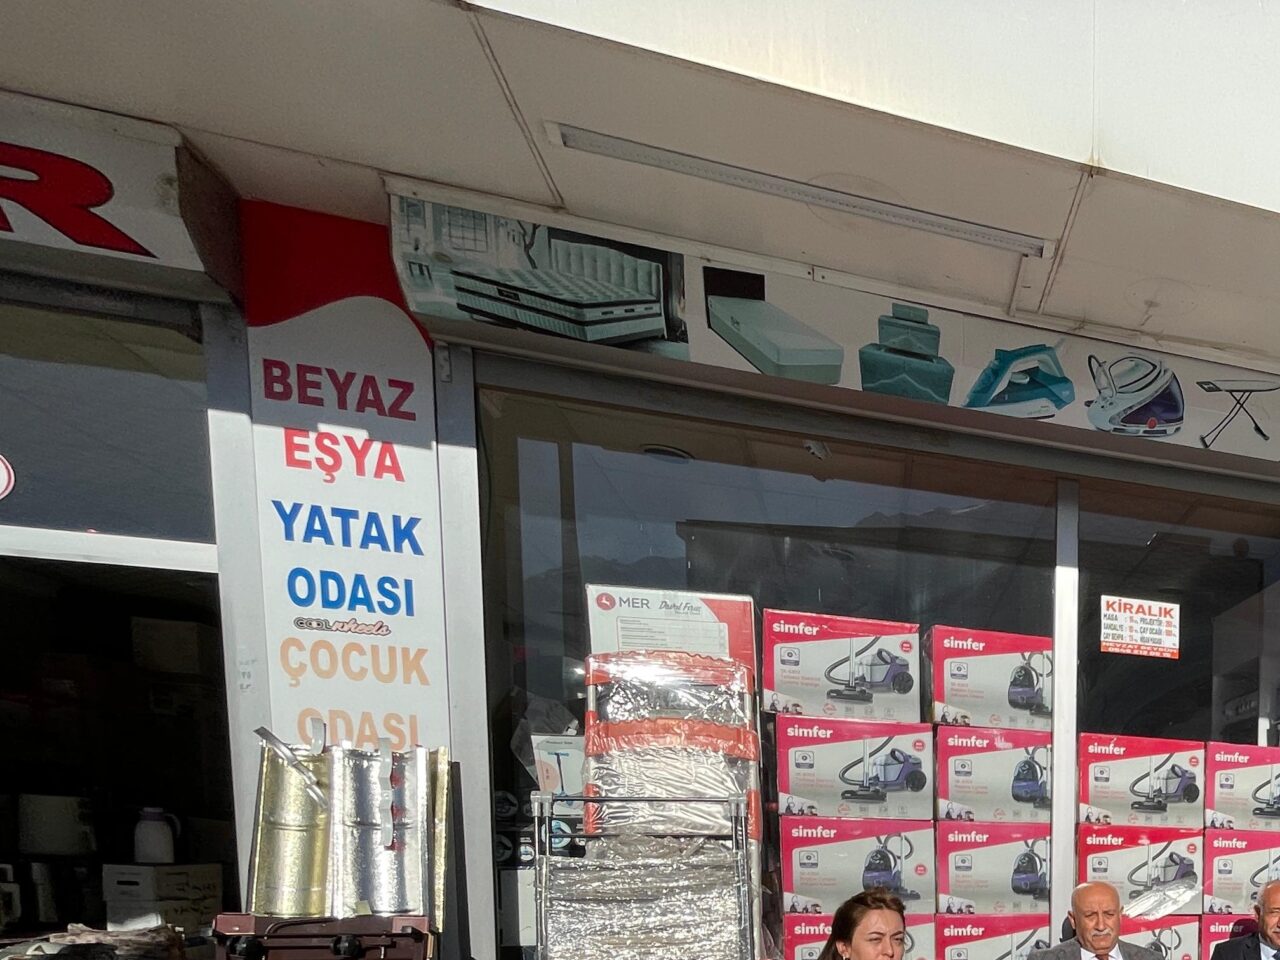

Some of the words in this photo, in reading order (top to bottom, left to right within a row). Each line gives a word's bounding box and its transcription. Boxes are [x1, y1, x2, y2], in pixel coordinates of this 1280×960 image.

[262, 358, 416, 421] BEYAZ
[284, 428, 405, 483] EŞYA
[271, 499, 424, 556] YATAK
[287, 567, 414, 617] ODASI
[619, 597, 650, 609] MER
[1106, 599, 1174, 619] KİRALIK
[773, 621, 819, 636] simfer
[944, 637, 985, 651] simfer
[280, 636, 430, 687] ÇOCUK
[297, 708, 418, 752] ODASI
[787, 725, 833, 739] simfer
[948, 735, 989, 749] simfer
[1088, 744, 1126, 755] simfer
[1215, 752, 1250, 763] simfer
[791, 826, 837, 840] simfer
[948, 831, 989, 843] simfer
[1086, 835, 1124, 846] simfer
[1213, 838, 1247, 849] simfer
[794, 923, 832, 935] simfe
[944, 924, 984, 937] simfer
[1209, 923, 1244, 934] simfer
